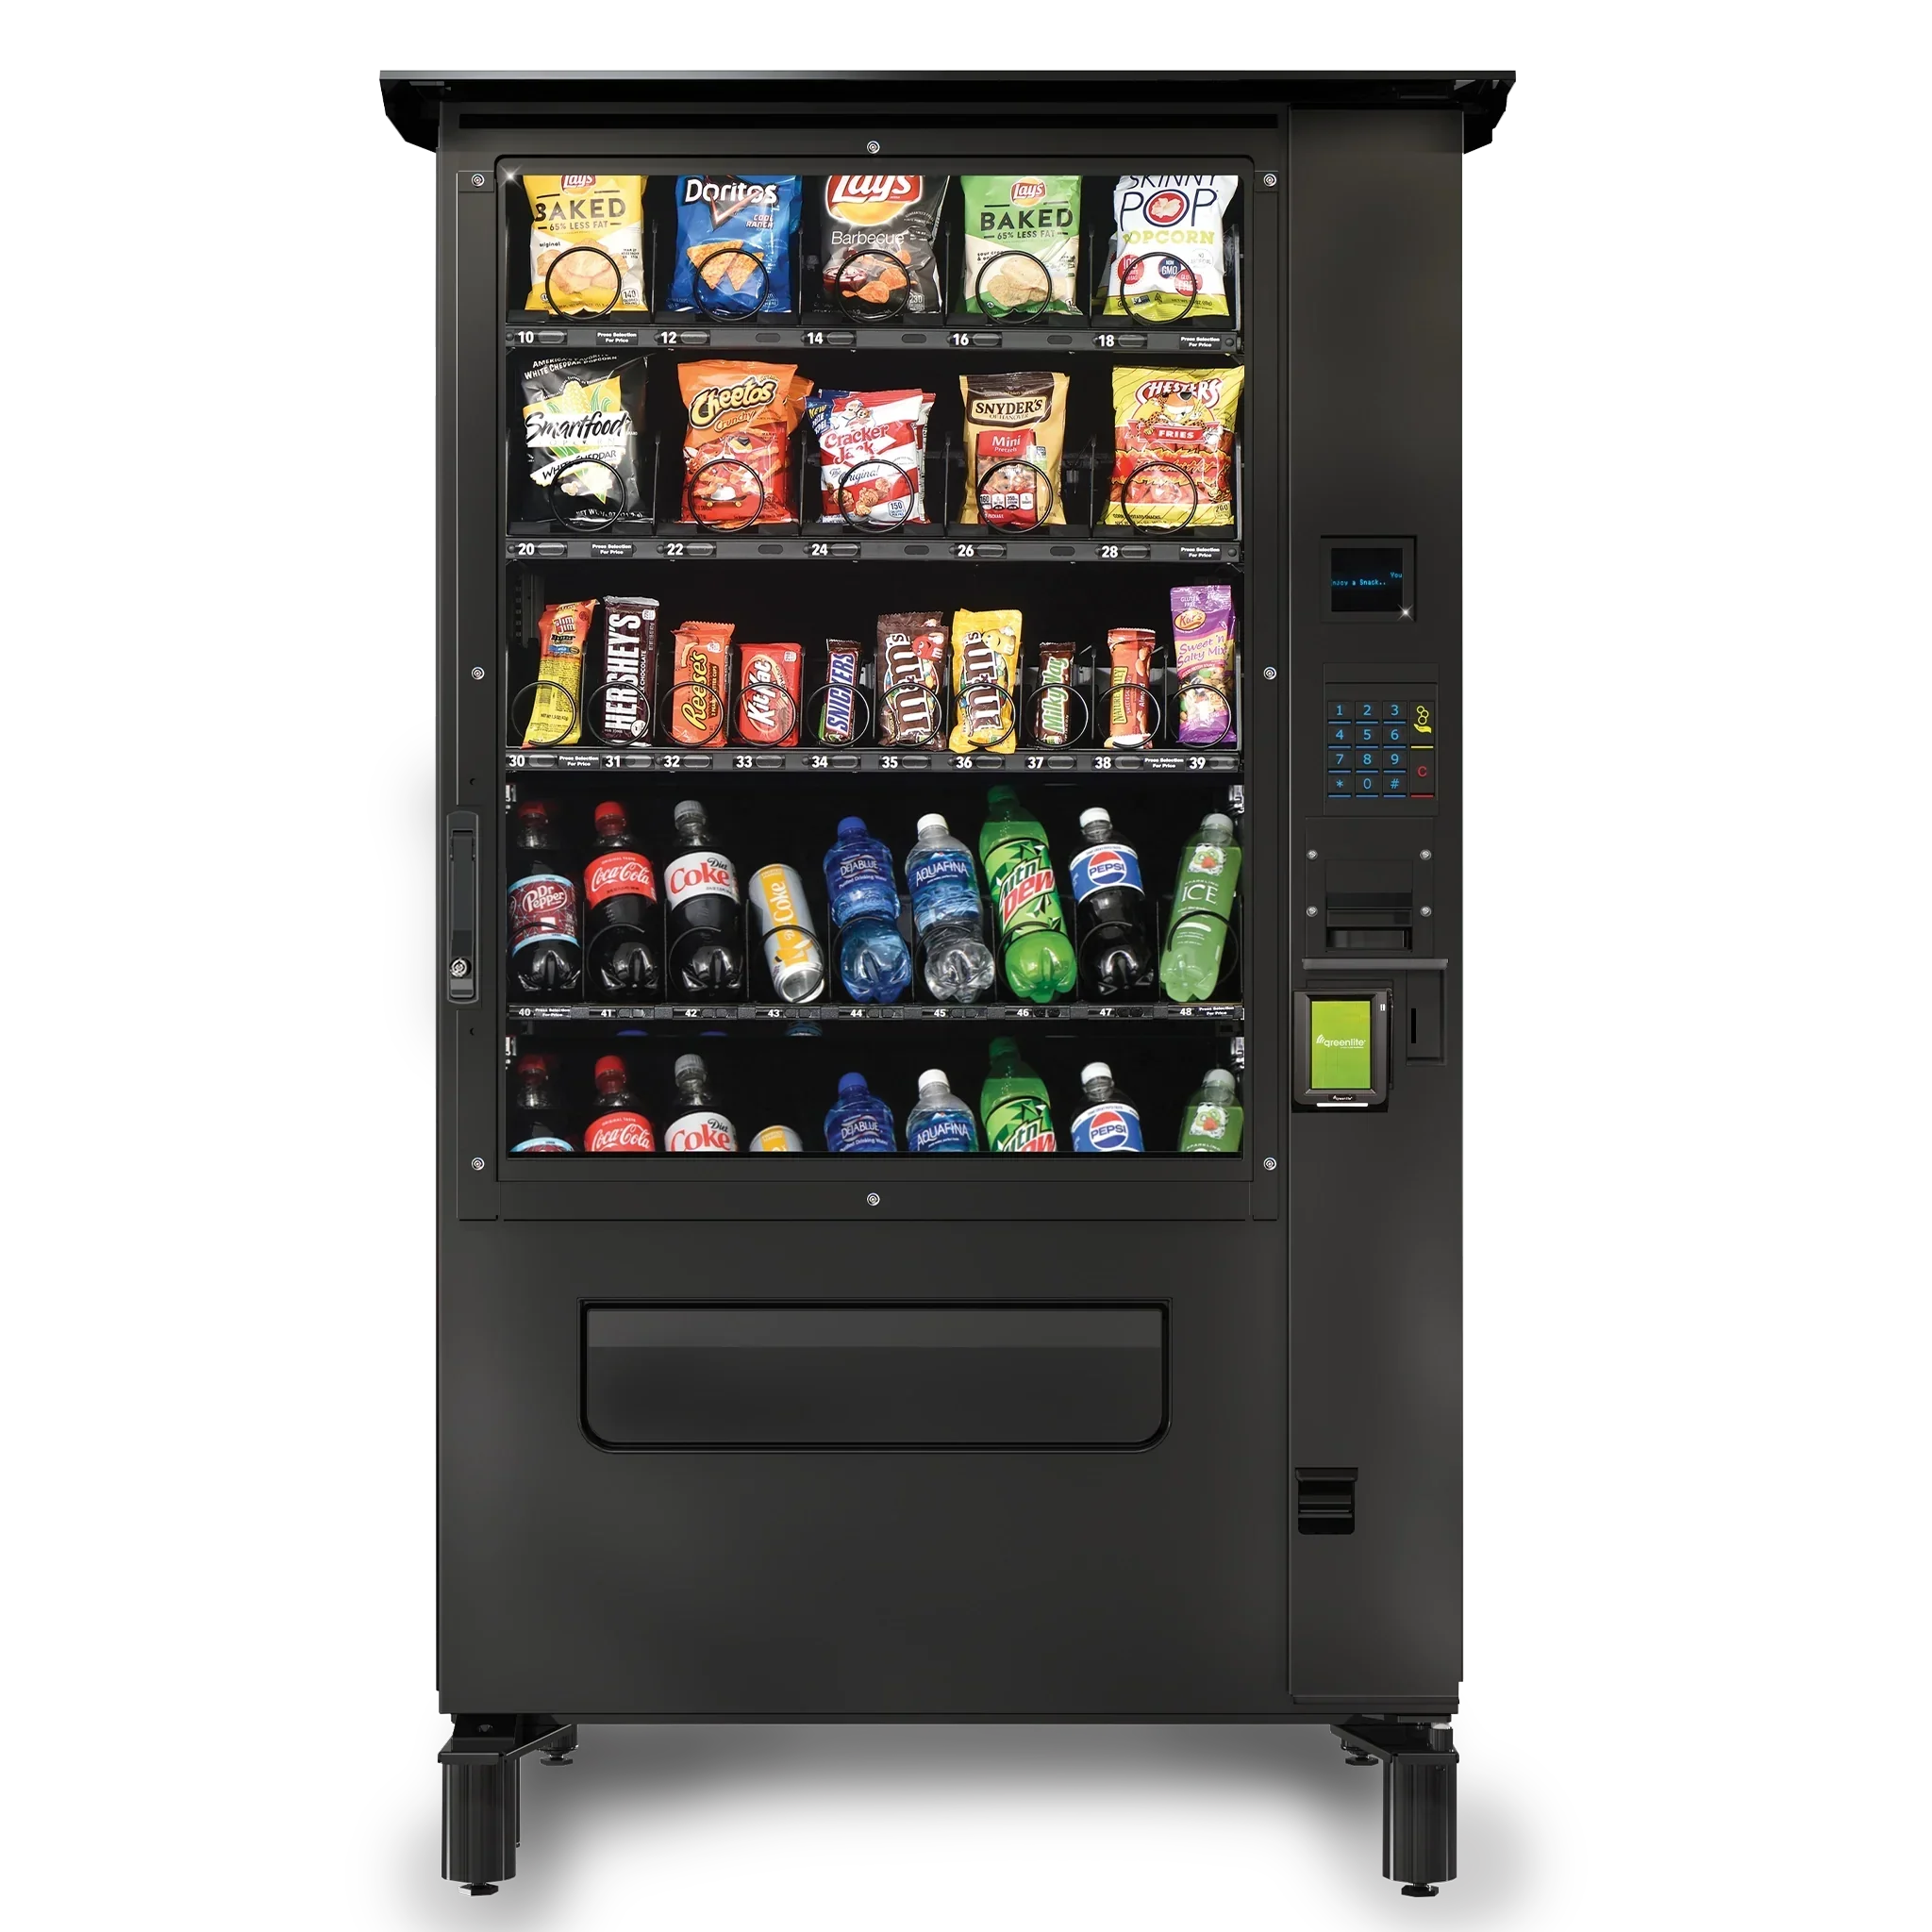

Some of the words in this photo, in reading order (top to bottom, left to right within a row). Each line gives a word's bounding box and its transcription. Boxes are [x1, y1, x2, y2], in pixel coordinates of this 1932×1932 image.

[563, 175, 593, 188] Lays
[685, 178, 777, 204] Doritos
[832, 175, 913, 203] Lays
[534, 197, 625, 223] BAKED
[1120, 188, 1218, 232] POP
[549, 223, 567, 231] 65%
[570, 221, 590, 230] LESS
[592, 220, 608, 228] FAT
[745, 221, 774, 229] RANCH
[980, 208, 1074, 231] BAKED
[831, 230, 906, 245] Barbecue
[996, 231, 1014, 241] 65%
[1017, 230, 1038, 240] LESS
[1040, 229, 1056, 238] FAT
[1161, 265, 1177, 275] GMO
[518, 330, 535, 344] 10
[660, 331, 677, 344] 12
[807, 332, 824, 344] 14
[953, 333, 970, 345] 16
[1098, 334, 1115, 347] 18
[524, 365, 548, 380] WHITE
[549, 359, 582, 373] CHEDDAR
[1135, 378, 1224, 408] CHESTER'S
[691, 377, 775, 426] Cheetos
[974, 398, 1043, 415] SNYDER'S
[525, 410, 626, 443] Smartfood
[715, 409, 754, 431] Crunchy
[824, 425, 890, 449] Cracker
[991, 435, 1021, 447] Mini
[1158, 430, 1194, 440] FRIES
[890, 502, 904, 510] 150
[518, 542, 535, 556] 20
[667, 543, 684, 556] 22
[811, 543, 828, 556] 24
[958, 544, 974, 557] 26
[1101, 545, 1119, 558] 28
[1179, 640, 1214, 655] Sweet
[1177, 651, 1206, 668] Salty
[1208, 645, 1226, 658] Mix
[605, 613, 641, 731] HERSHEY'S
[639, 650, 647, 687] CHOCOLATE
[1041, 657, 1069, 686] Way
[1113, 668, 1125, 692] VLLEY
[681, 650, 708, 730] Reese's
[1138, 682, 1146, 708] Almod
[1041, 686, 1068, 734] Milky
[1113, 692, 1125, 724] NATURE
[1336, 705, 1342, 716] 1
[1363, 705, 1372, 716] 2
[1391, 705, 1399, 716] 3
[1336, 729, 1344, 741] 4
[1363, 729, 1372, 741] 5
[1391, 729, 1399, 741] 6
[508, 755, 525, 767] 30
[605, 755, 621, 767] 31
[664, 756, 680, 768] 32
[736, 756, 753, 768] 33
[811, 756, 828, 768] 34
[882, 756, 898, 768] 35
[956, 756, 973, 769] 36
[1027, 756, 1044, 769] 37
[1094, 757, 1111, 769] 38
[1189, 757, 1206, 769] 39
[1336, 754, 1344, 765] 7
[1363, 754, 1372, 765] 8
[1391, 754, 1399, 765] 9
[1417, 766, 1427, 777] C
[1363, 777, 1372, 790] 0
[707, 858, 728, 871] Diet
[1089, 863, 1125, 876] PEPSI
[591, 861, 649, 892] Coca-Cola
[670, 862, 731, 895] Coke
[916, 860, 971, 887] AQUAFINA
[537, 885, 555, 897] Dr
[1181, 884, 1219, 905] ICE
[526, 890, 566, 912] Pepper
[770, 882, 795, 923] Coke
[519, 1008, 531, 1016] 40
[600, 1008, 613, 1018] 41
[685, 1008, 698, 1018] 42
[767, 1008, 780, 1018] 43
[850, 1008, 863, 1018] 44
[933, 1008, 946, 1018] 45
[1016, 1008, 1029, 1017] 46
[1099, 1008, 1112, 1017] 47
[1179, 1008, 1192, 1017] 48
[1324, 1038, 1364, 1048] greenlite
[708, 1118, 729, 1133] Diet
[1090, 1124, 1127, 1140] PEPSI
[591, 1123, 651, 1151] Coca-Cola
[671, 1124, 731, 1151] Coke
[916, 1123, 972, 1151] AQUAFINA
